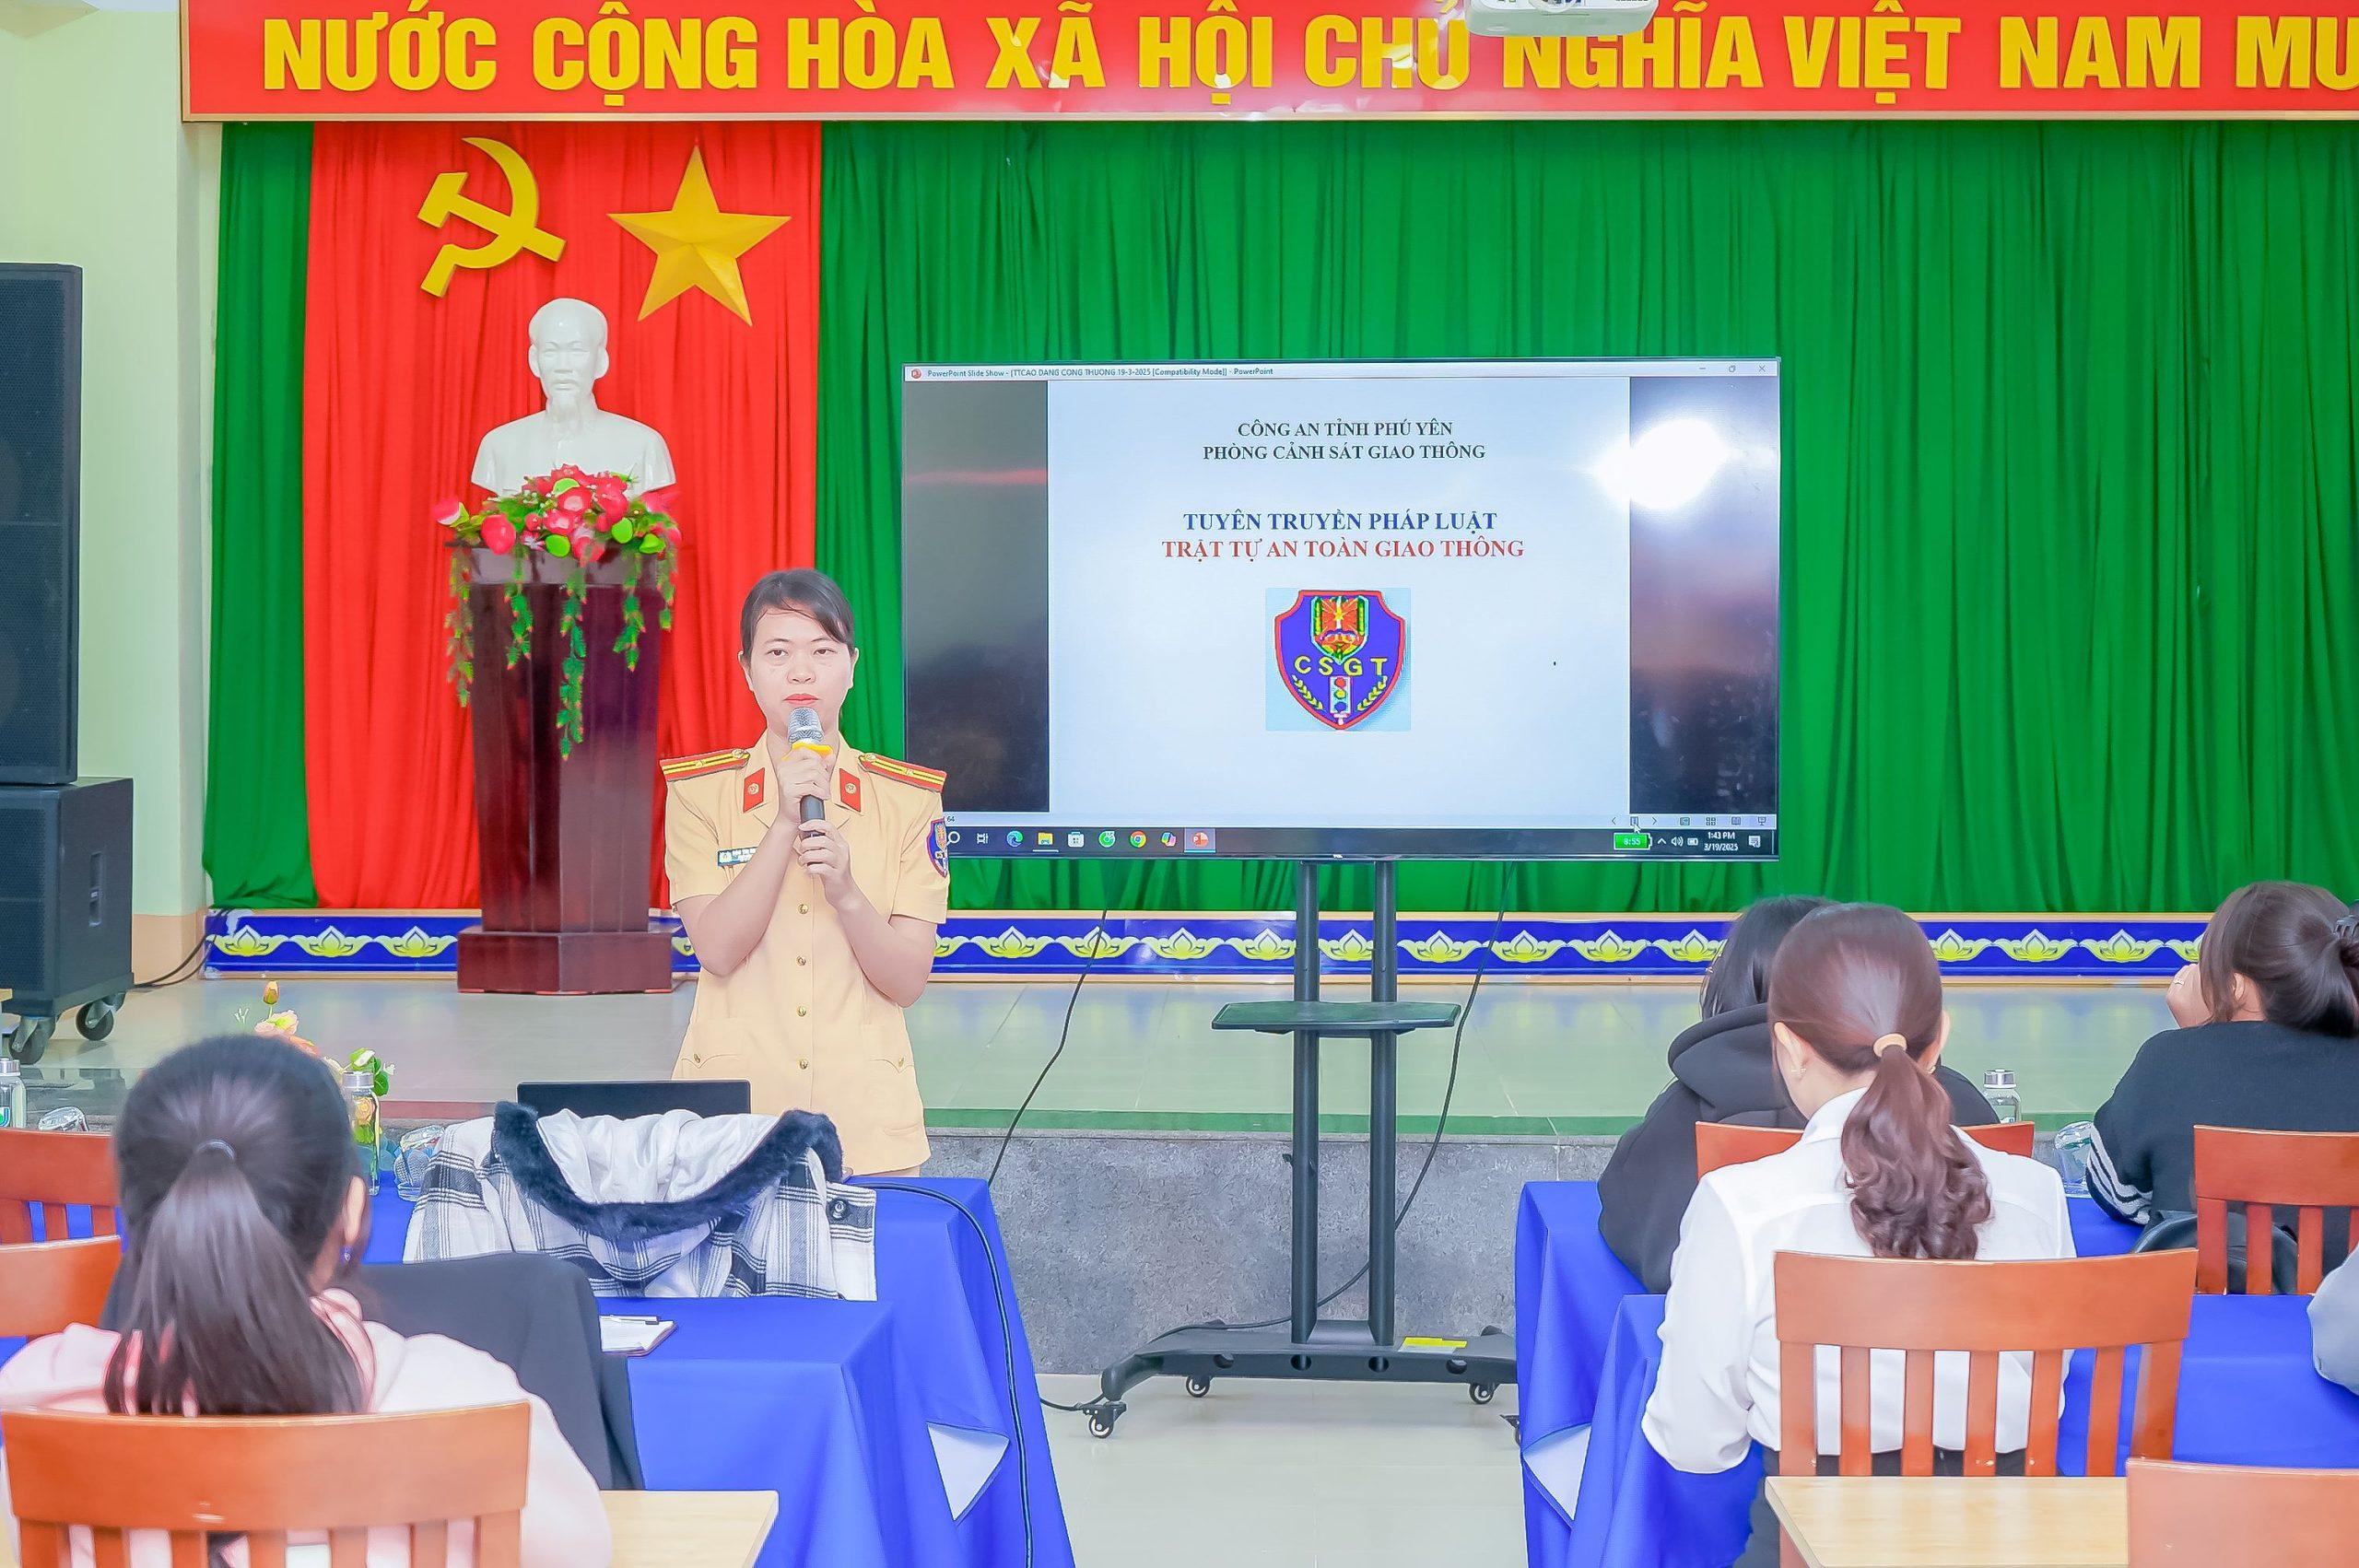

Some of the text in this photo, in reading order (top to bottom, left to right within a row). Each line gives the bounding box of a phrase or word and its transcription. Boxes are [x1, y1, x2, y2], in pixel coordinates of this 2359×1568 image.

[264, 0, 496, 91] NƯỚC
[533, 1, 757, 106] CỘNG
[787, 0, 955, 89] HÒA
[986, 1, 1106, 89] XÃ
[1138, 0, 1273, 104] HỘI
[1304, 0, 1471, 90] CHỦ
[1503, 0, 1764, 89] NGHĨA
[1784, 0, 1962, 103] VIỆT
[2000, 16, 2201, 88] NAM
[927, 369, 967, 378] PowerPoint
[968, 369, 984, 378] Slide
[1118, 368, 1151, 376] 19-3-2025
[1152, 368, 1200, 377] [Compatibility
[1238, 417, 1453, 437] CÔNG AN TỈNH PHÚ YÊN
[1202, 440, 1486, 461] PHÒNG CẢNH SÁT GIAO THÔNG
[1183, 508, 1262, 531] TUYÊN
[1368, 509, 1430, 531] PHÁP
[1228, 538, 1263, 563] TỰ
[1266, 540, 1298, 557] AN
[1304, 536, 1369, 557] TOÀN
[1375, 539, 1435, 557] GIAO
[1440, 534, 1525, 557] THÔNG
[1708, 831, 1736, 840] 1:43 PM
